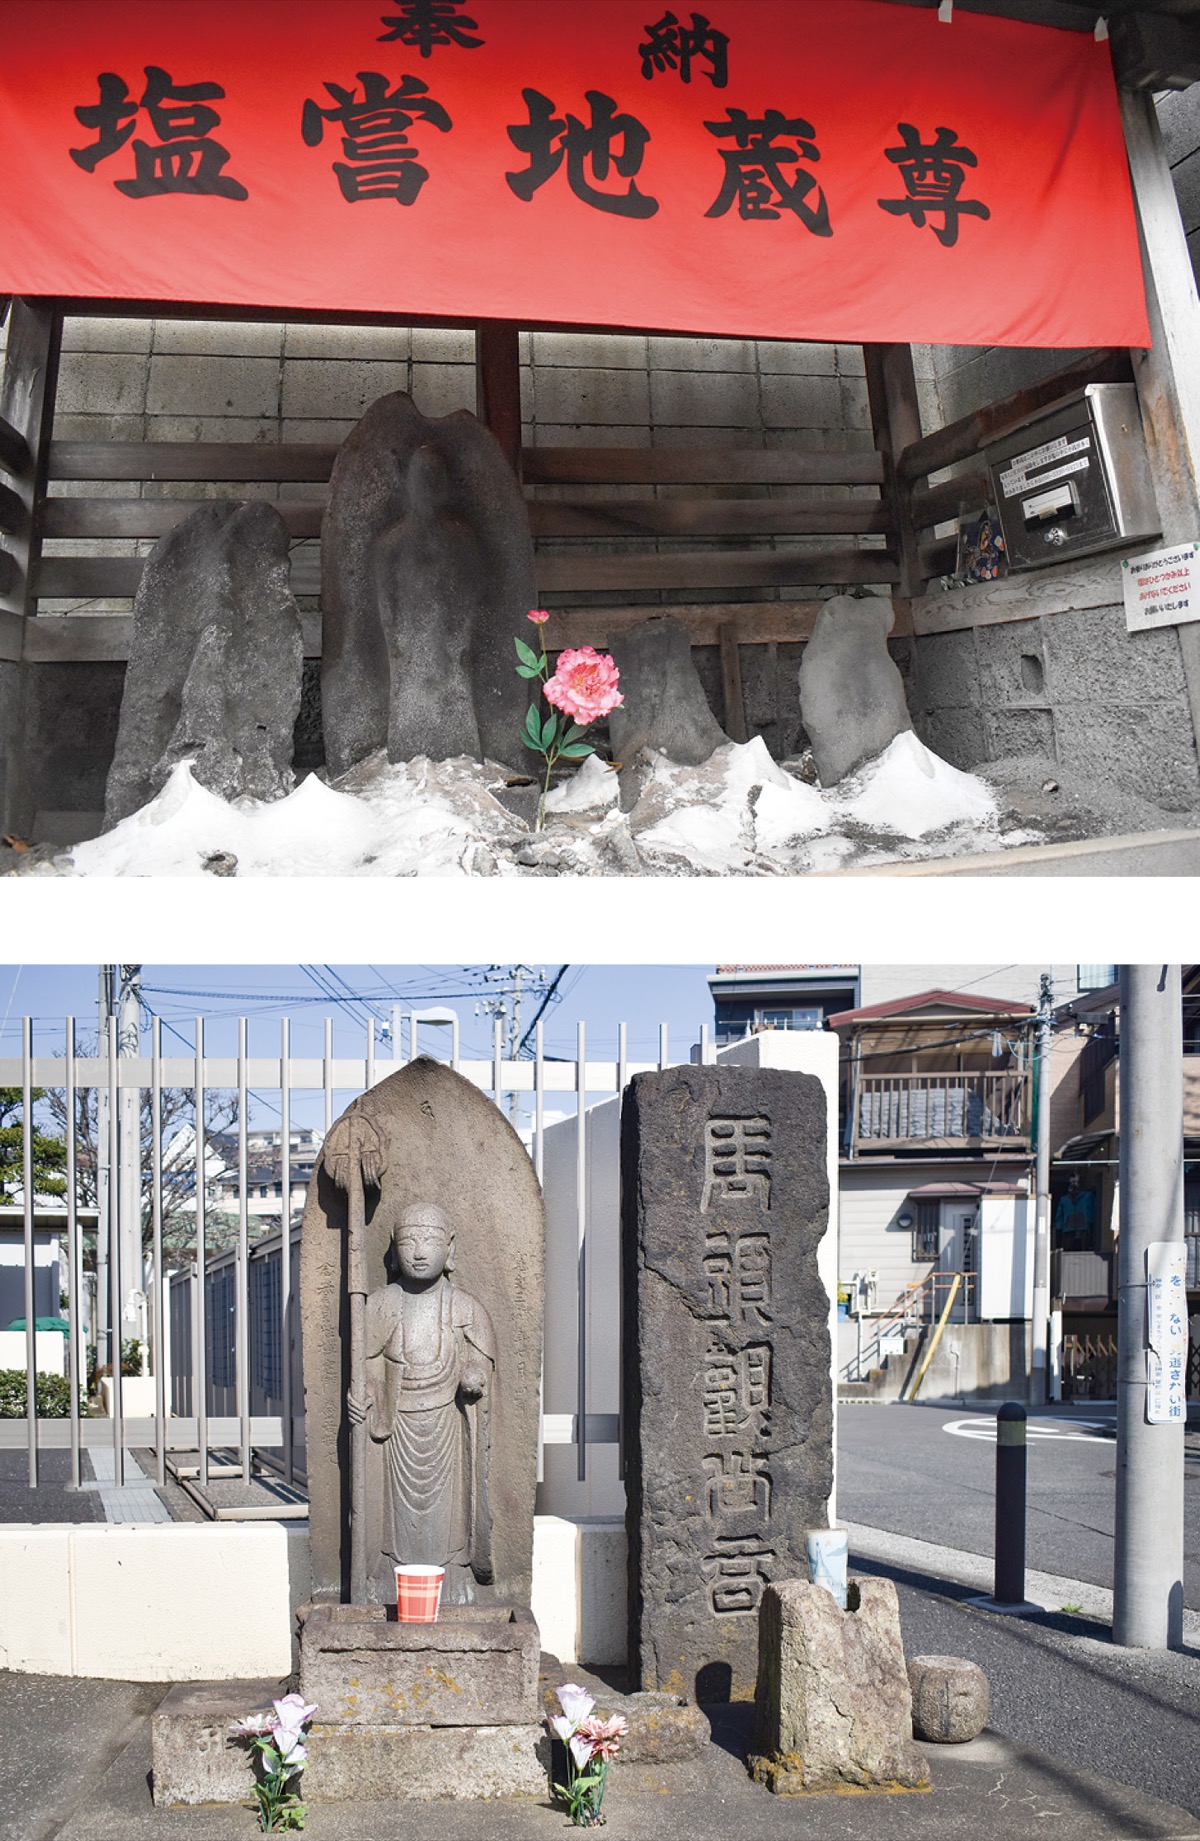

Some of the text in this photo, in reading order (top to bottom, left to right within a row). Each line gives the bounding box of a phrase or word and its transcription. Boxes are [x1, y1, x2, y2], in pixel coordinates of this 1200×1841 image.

[69, 65, 991, 247] 塩嘗地蔵尊
